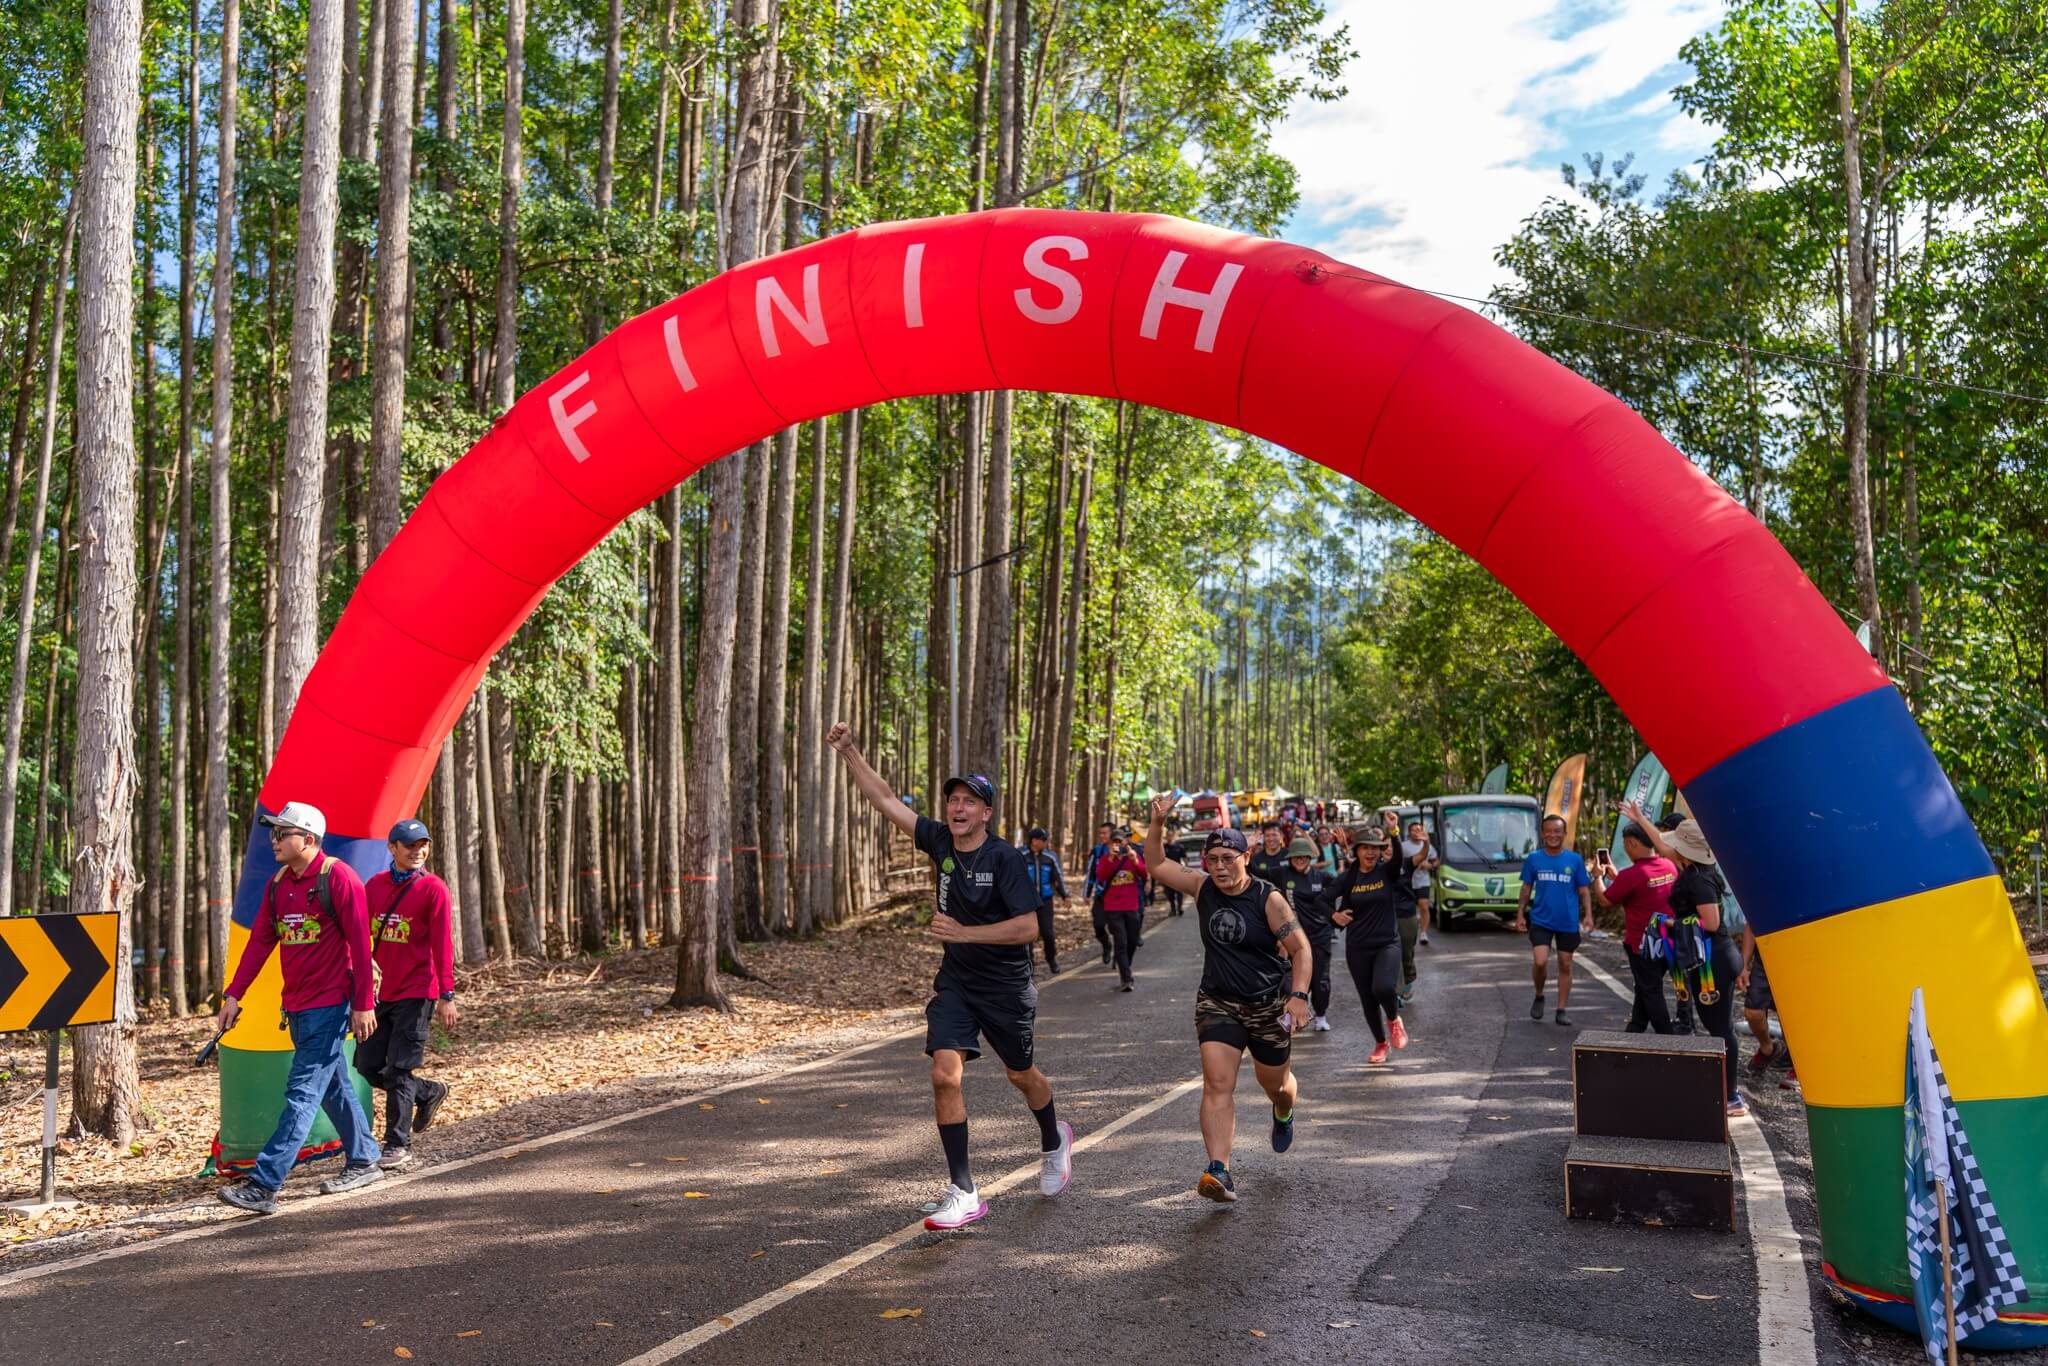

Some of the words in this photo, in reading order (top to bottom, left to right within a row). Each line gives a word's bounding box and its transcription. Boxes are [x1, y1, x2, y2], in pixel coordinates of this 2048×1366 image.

[548, 235, 1245, 464] FINISH
[975, 872, 993, 882] 5KM
[1491, 879, 1504, 896] 7
